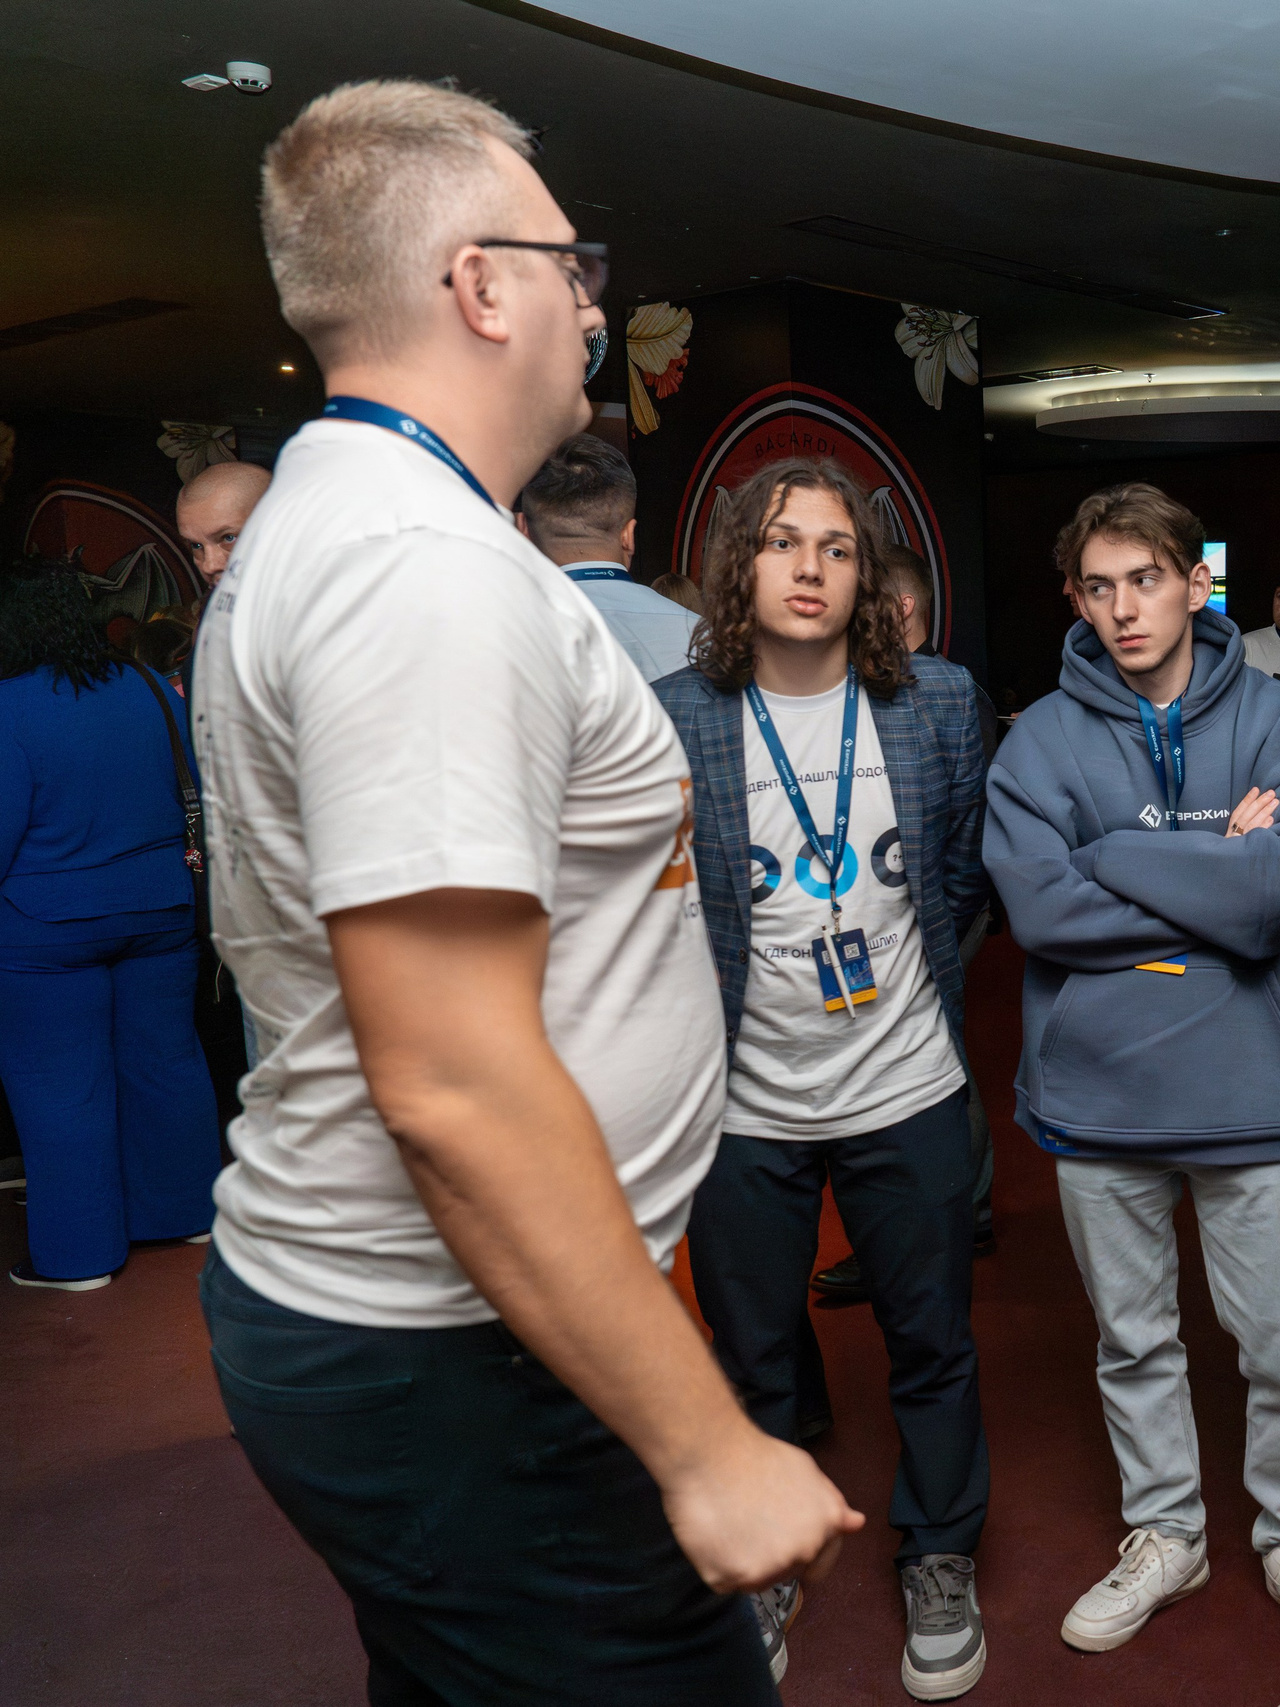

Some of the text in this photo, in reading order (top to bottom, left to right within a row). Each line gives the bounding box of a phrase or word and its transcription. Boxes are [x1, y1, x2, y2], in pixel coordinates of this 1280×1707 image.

[745, 778, 785, 795] ДЕНТ
[764, 948, 788, 959] ГДЕ
[867, 932, 898, 950] ШЛИ?
